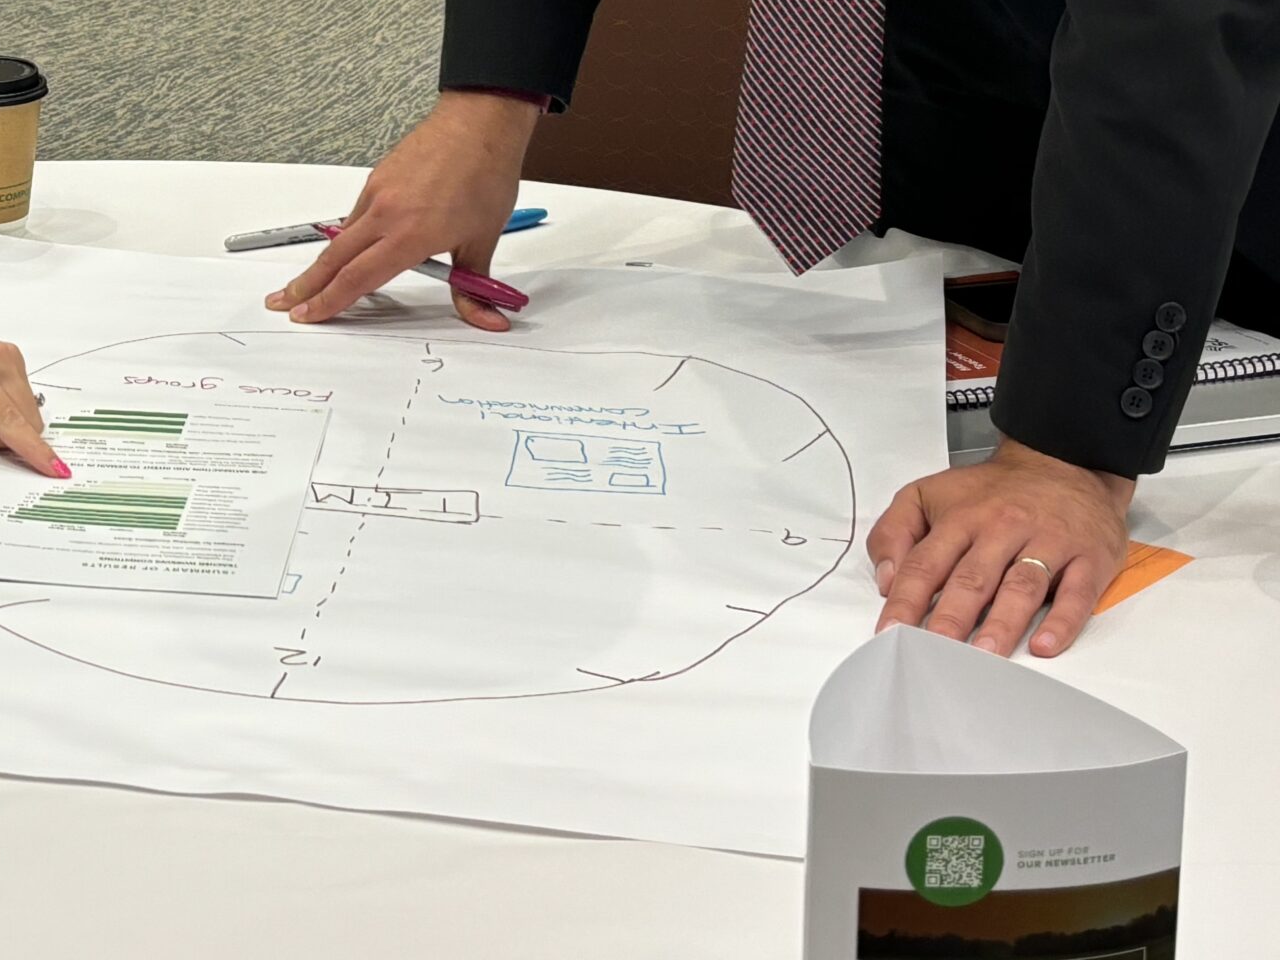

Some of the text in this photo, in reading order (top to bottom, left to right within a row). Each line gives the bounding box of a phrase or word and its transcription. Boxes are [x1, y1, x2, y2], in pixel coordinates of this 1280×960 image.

[123, 376, 333, 402] Focus groups
[478, 408, 706, 435] Intentional
[81, 562, 137, 571] RESULTS
[162, 566, 229, 575] SUMMARY
[273, 647, 321, 667] 12
[1017, 846, 1089, 859] SIGN UP FOR
[1017, 853, 1116, 869] OUR NEWSLETTER
